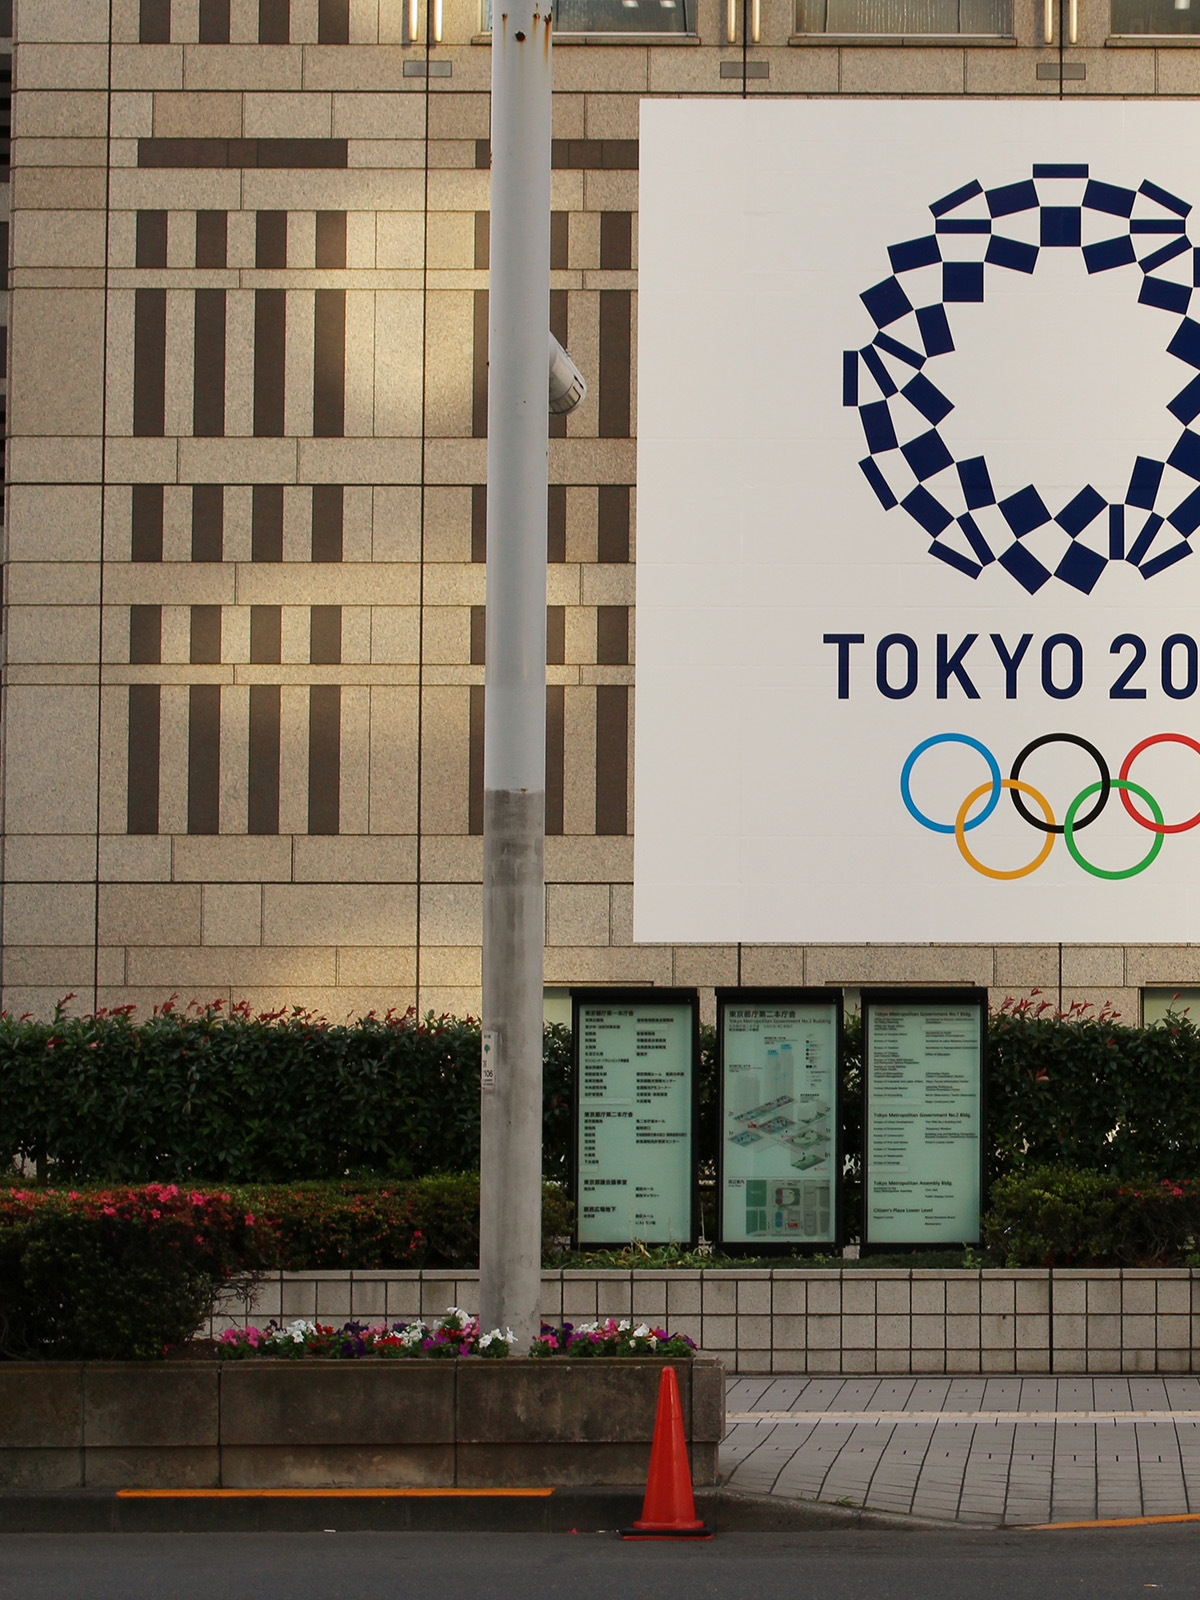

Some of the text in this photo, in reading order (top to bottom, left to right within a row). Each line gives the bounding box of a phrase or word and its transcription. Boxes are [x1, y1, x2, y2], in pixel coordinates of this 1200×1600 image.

[823, 633, 1083, 699] TOKYO
[729, 1010, 796, 1018] 東京都庁第二本庁舎
